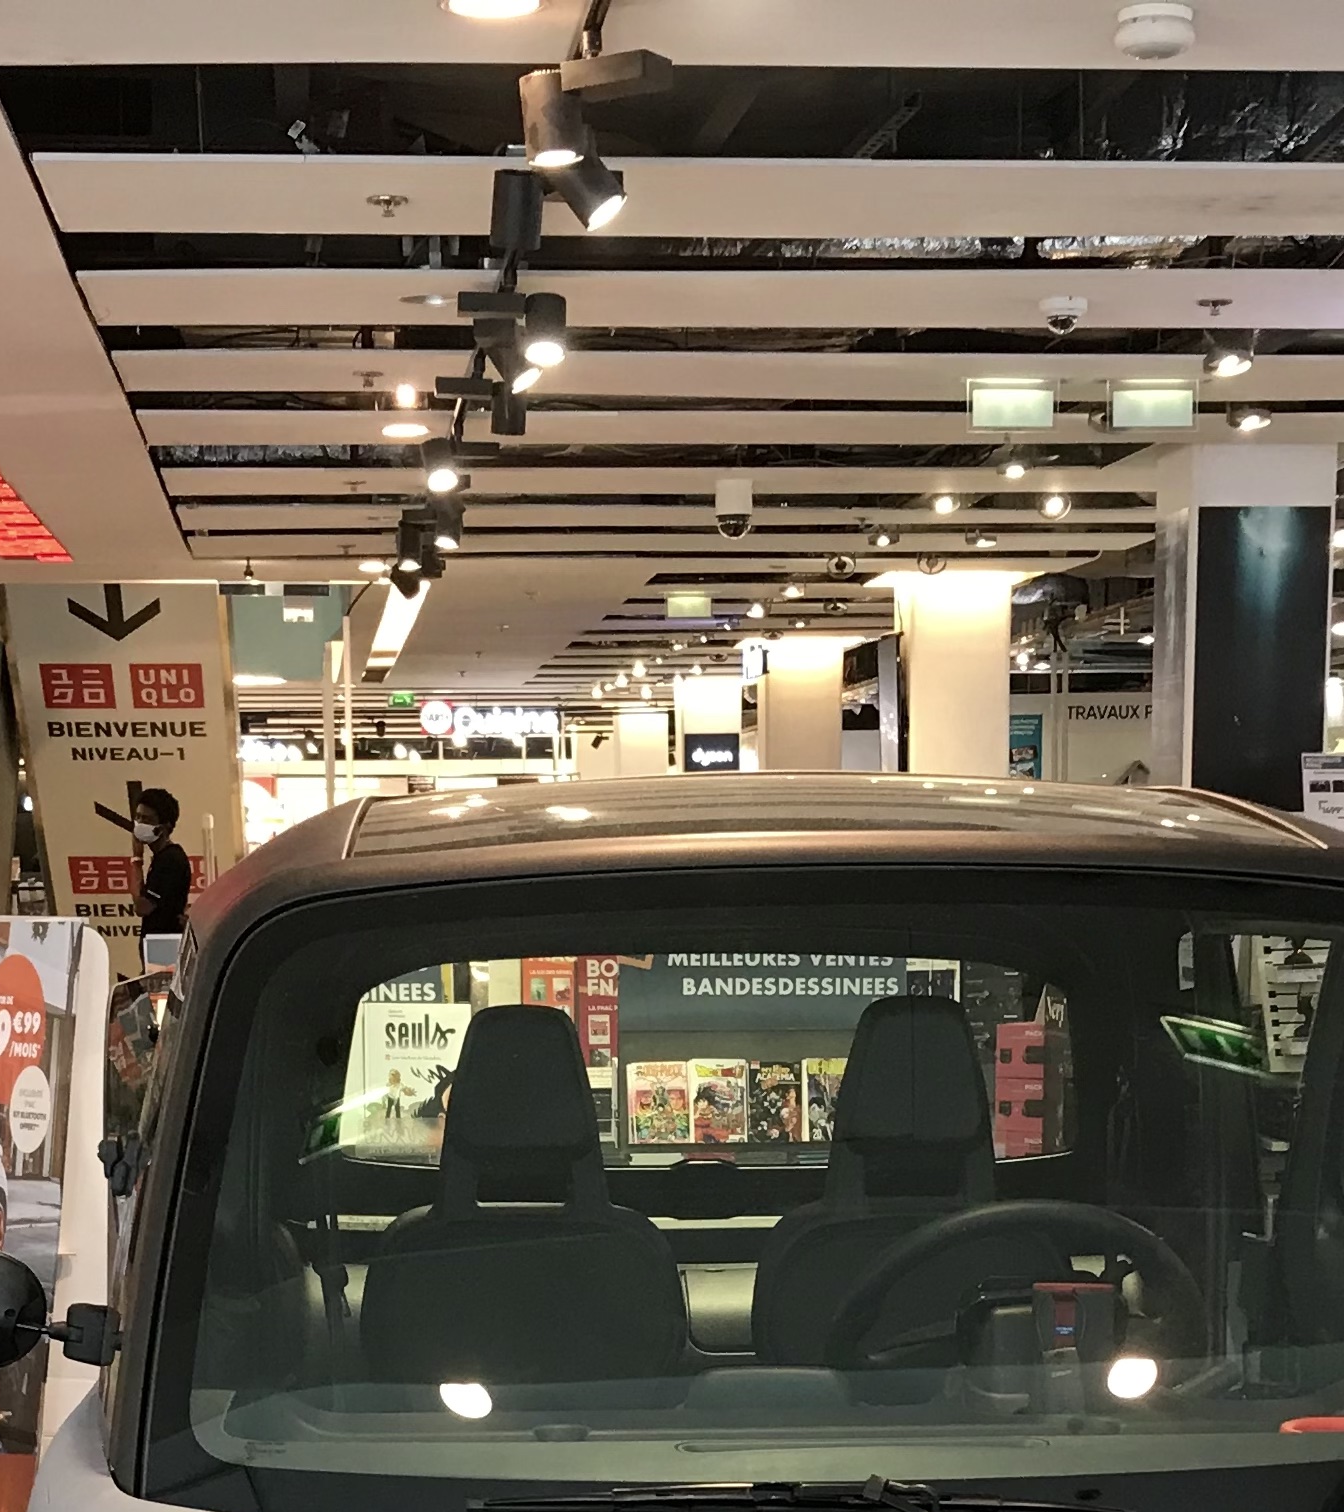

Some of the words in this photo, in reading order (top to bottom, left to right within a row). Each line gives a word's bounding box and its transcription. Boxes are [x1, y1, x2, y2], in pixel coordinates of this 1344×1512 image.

[138, 669, 190, 685] UNI
[141, 688, 196, 706] QLO
[1067, 705, 1140, 720] TRAVAUX
[47, 721, 207, 737] BIENVENUE
[71, 747, 185, 761] NIVEAU-1
[75, 904, 135, 917] BIEN
[97, 925, 142, 937] NIVE
[587, 979, 618, 997] FN
[682, 977, 899, 996] BANDESDESSINEES
[385, 1014, 456, 1049] seuls
